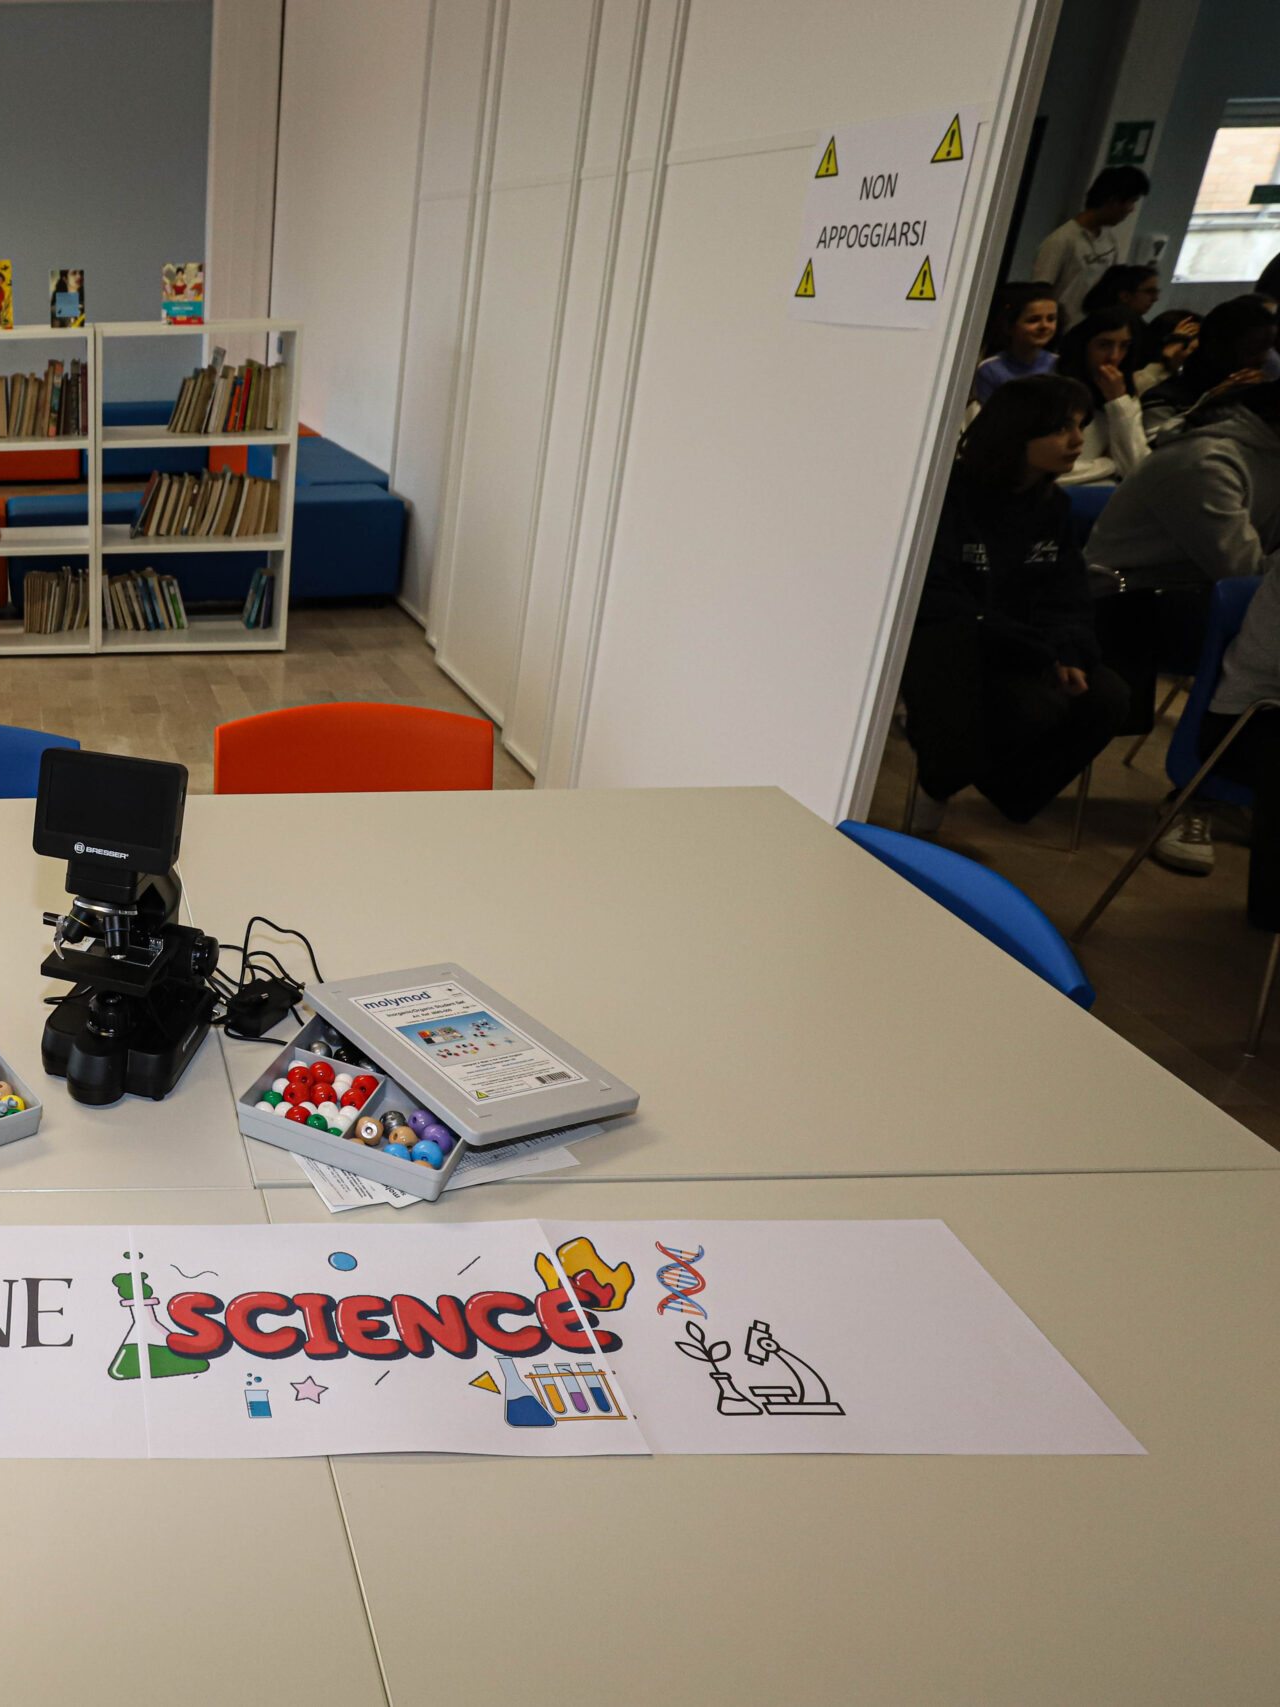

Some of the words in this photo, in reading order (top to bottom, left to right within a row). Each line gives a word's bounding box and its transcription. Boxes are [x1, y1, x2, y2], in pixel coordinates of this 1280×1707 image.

[859, 172, 899, 201] NON
[816, 220, 927, 249] APPOGGIARSI
[363, 991, 432, 1009] molymod
[166, 1290, 623, 1360] SCIENCE
